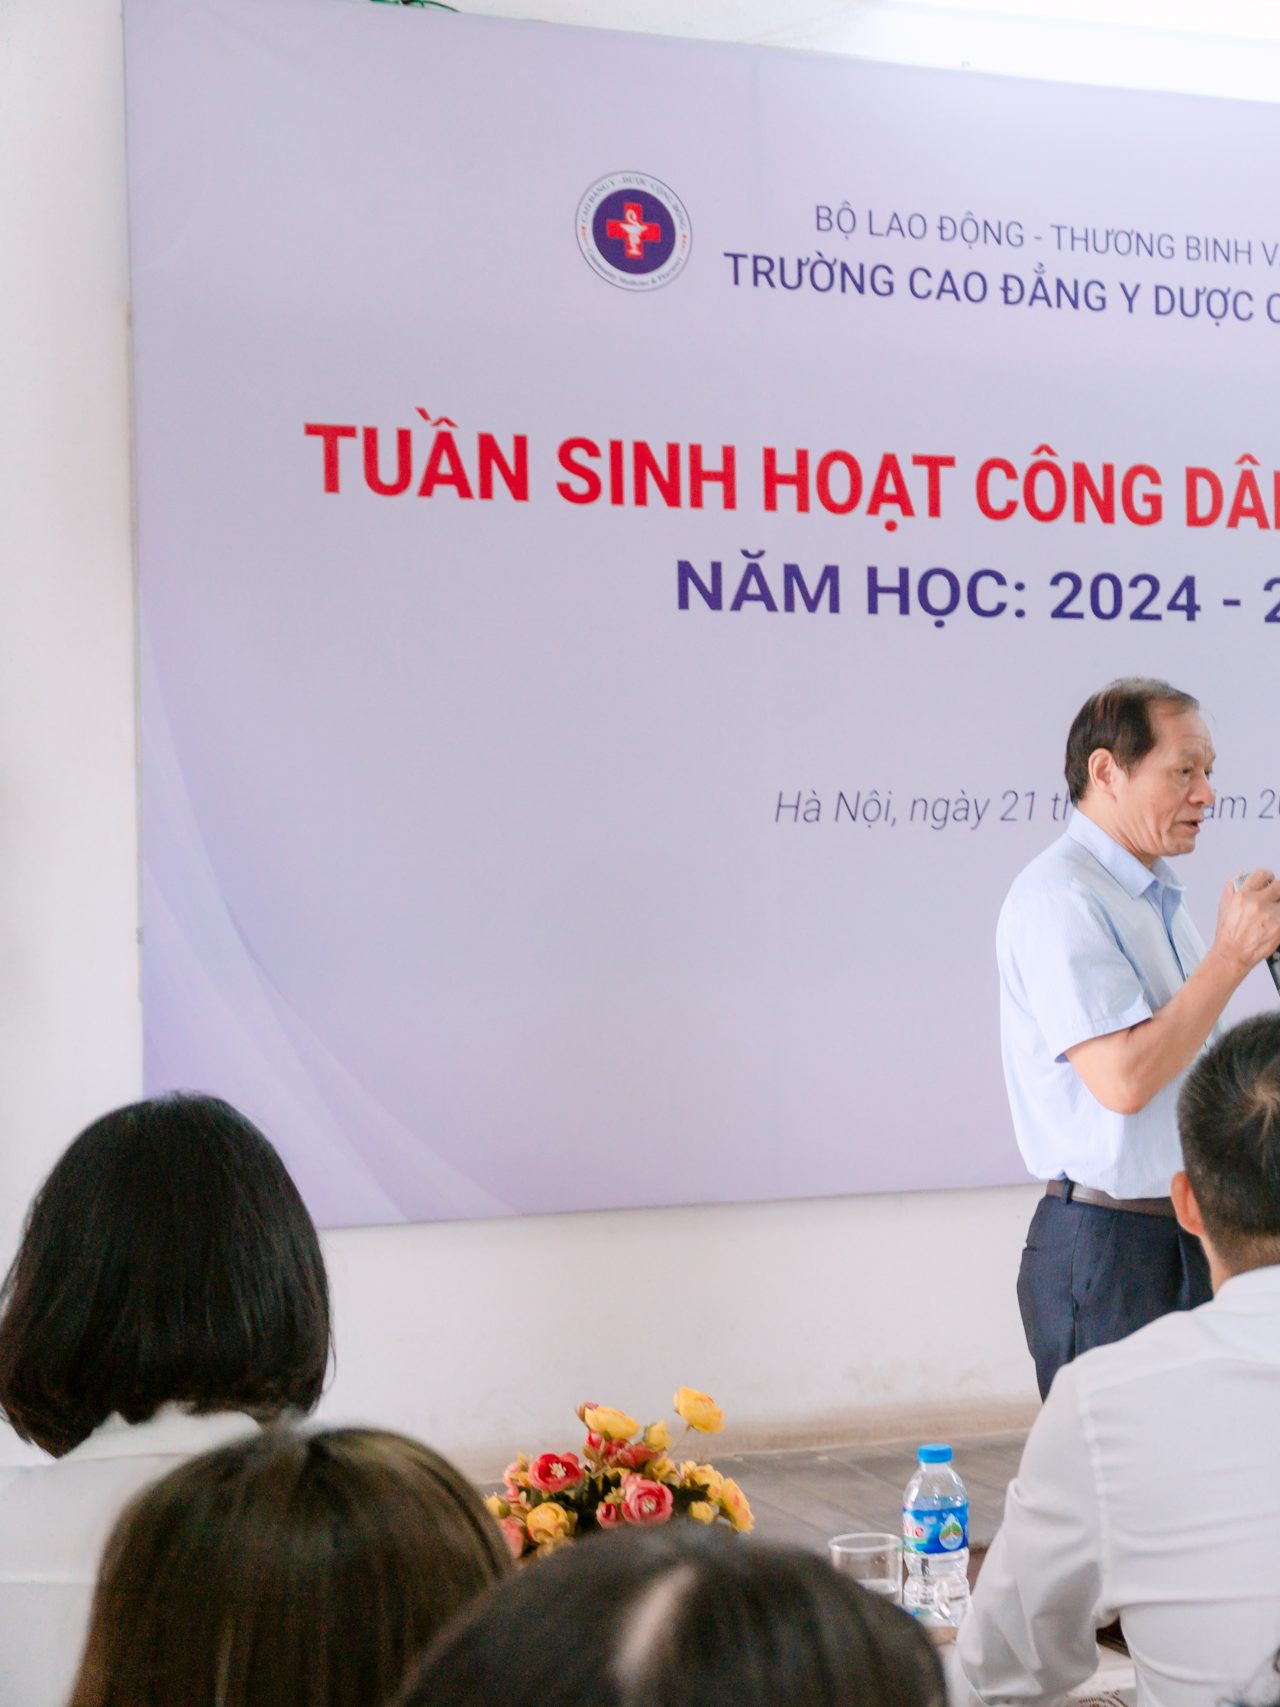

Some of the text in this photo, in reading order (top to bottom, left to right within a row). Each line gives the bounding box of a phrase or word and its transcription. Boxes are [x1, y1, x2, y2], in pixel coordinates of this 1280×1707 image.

[816, 201, 857, 241] BỘ
[868, 210, 928, 240] LAO
[937, 211, 1025, 250] ĐỘNG
[1050, 224, 1175, 260] THƯƠNG
[1185, 235, 1252, 265] BINH
[723, 251, 895, 298] TRƯỜNG
[908, 266, 989, 305] CAO
[1000, 262, 1107, 313] ĐẲNG
[1118, 281, 1142, 315] Y
[1154, 285, 1255, 328] DƯỢC
[304, 407, 529, 502] TUẦN
[556, 436, 736, 510] SINH
[763, 447, 956, 532] HOẠT
[976, 444, 1163, 526] CÔNG
[677, 549, 840, 614] NĂM
[867, 566, 1026, 629] HỌC:
[1050, 570, 1201, 623] 2024
[1222, 598, 1242, 607] -
[774, 789, 821, 824] Hà
[834, 789, 897, 829] Nội,
[909, 790, 990, 831] ngày
[1000, 790, 1036, 822] 21
